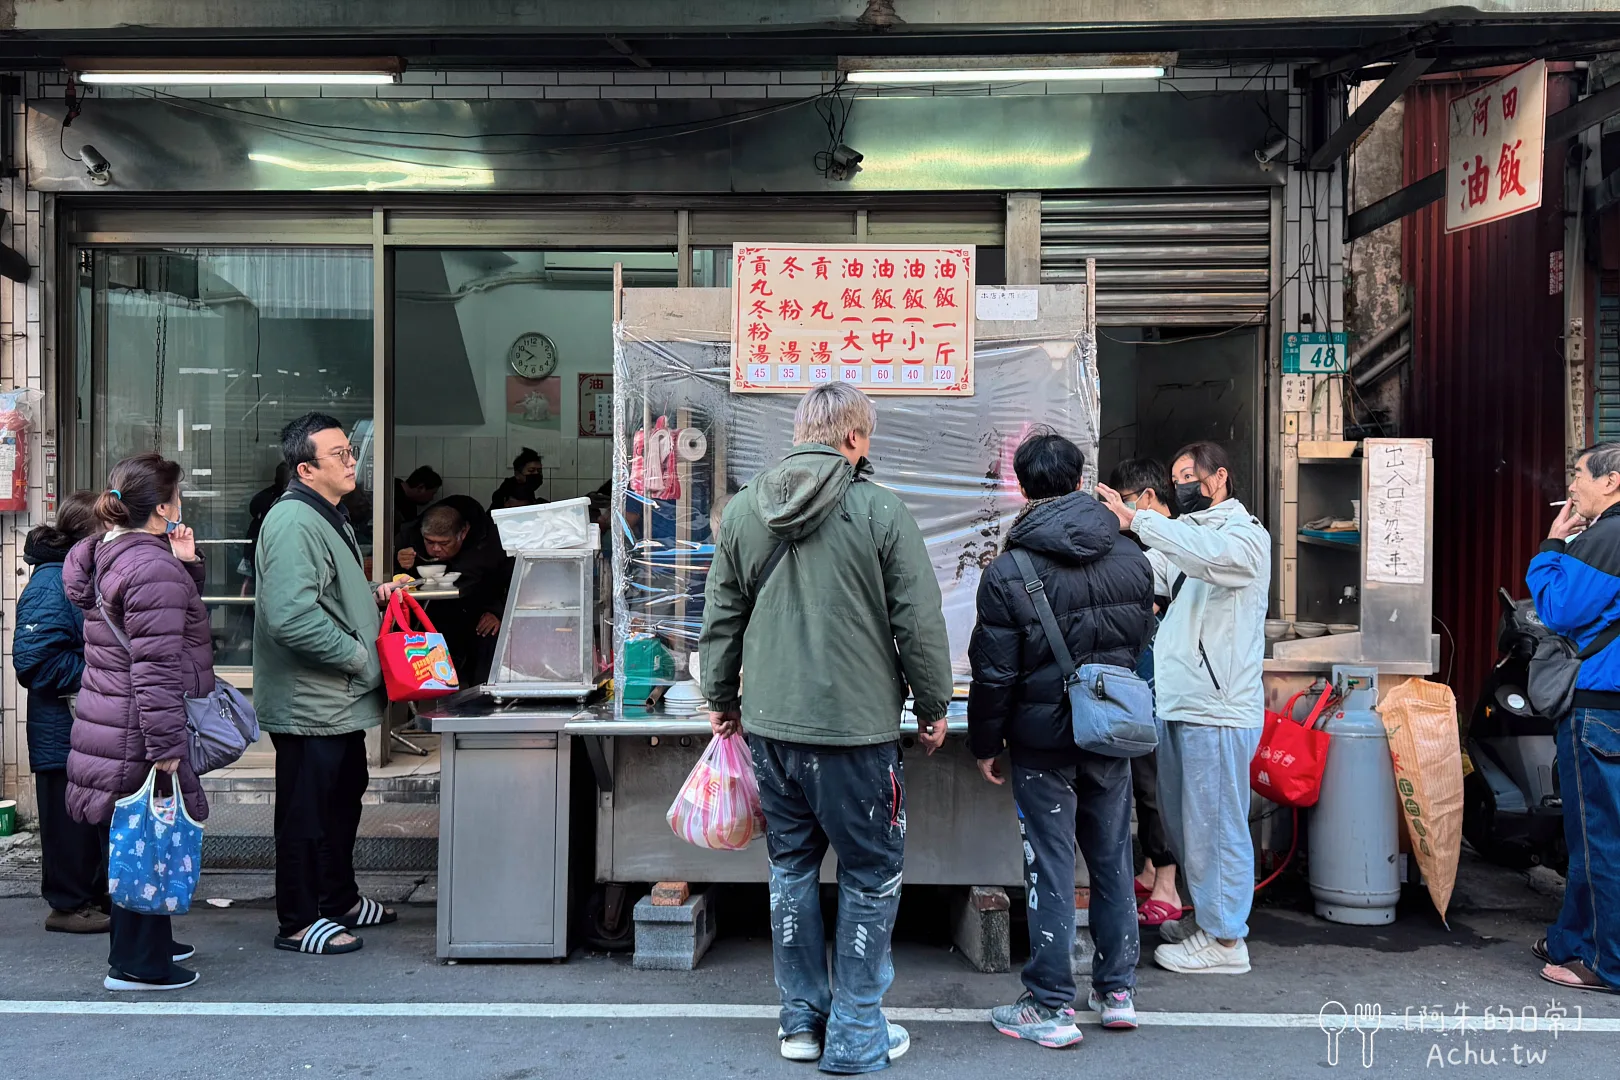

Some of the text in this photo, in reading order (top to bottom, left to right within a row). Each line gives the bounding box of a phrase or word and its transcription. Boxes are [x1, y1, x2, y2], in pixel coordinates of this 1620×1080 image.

[1472, 86, 1518, 137] 阿田
[1460, 139, 1527, 212] 油飯
[747, 255, 774, 364] 貢丸冬粉湯
[778, 255, 805, 364] 冬粉湯
[809, 256, 835, 364] 貢丸湯
[932, 257, 959, 366] 油飯一斤
[1310, 347, 1336, 368] 48
[754, 367, 766, 378] 45
[783, 367, 795, 378] 35
[815, 368, 827, 378] 35
[845, 369, 857, 379] 80
[877, 369, 889, 379] 60
[907, 369, 919, 379] 40
[935, 369, 952, 379] 120
[1377, 445, 1411, 576] 出入口請勿停車
